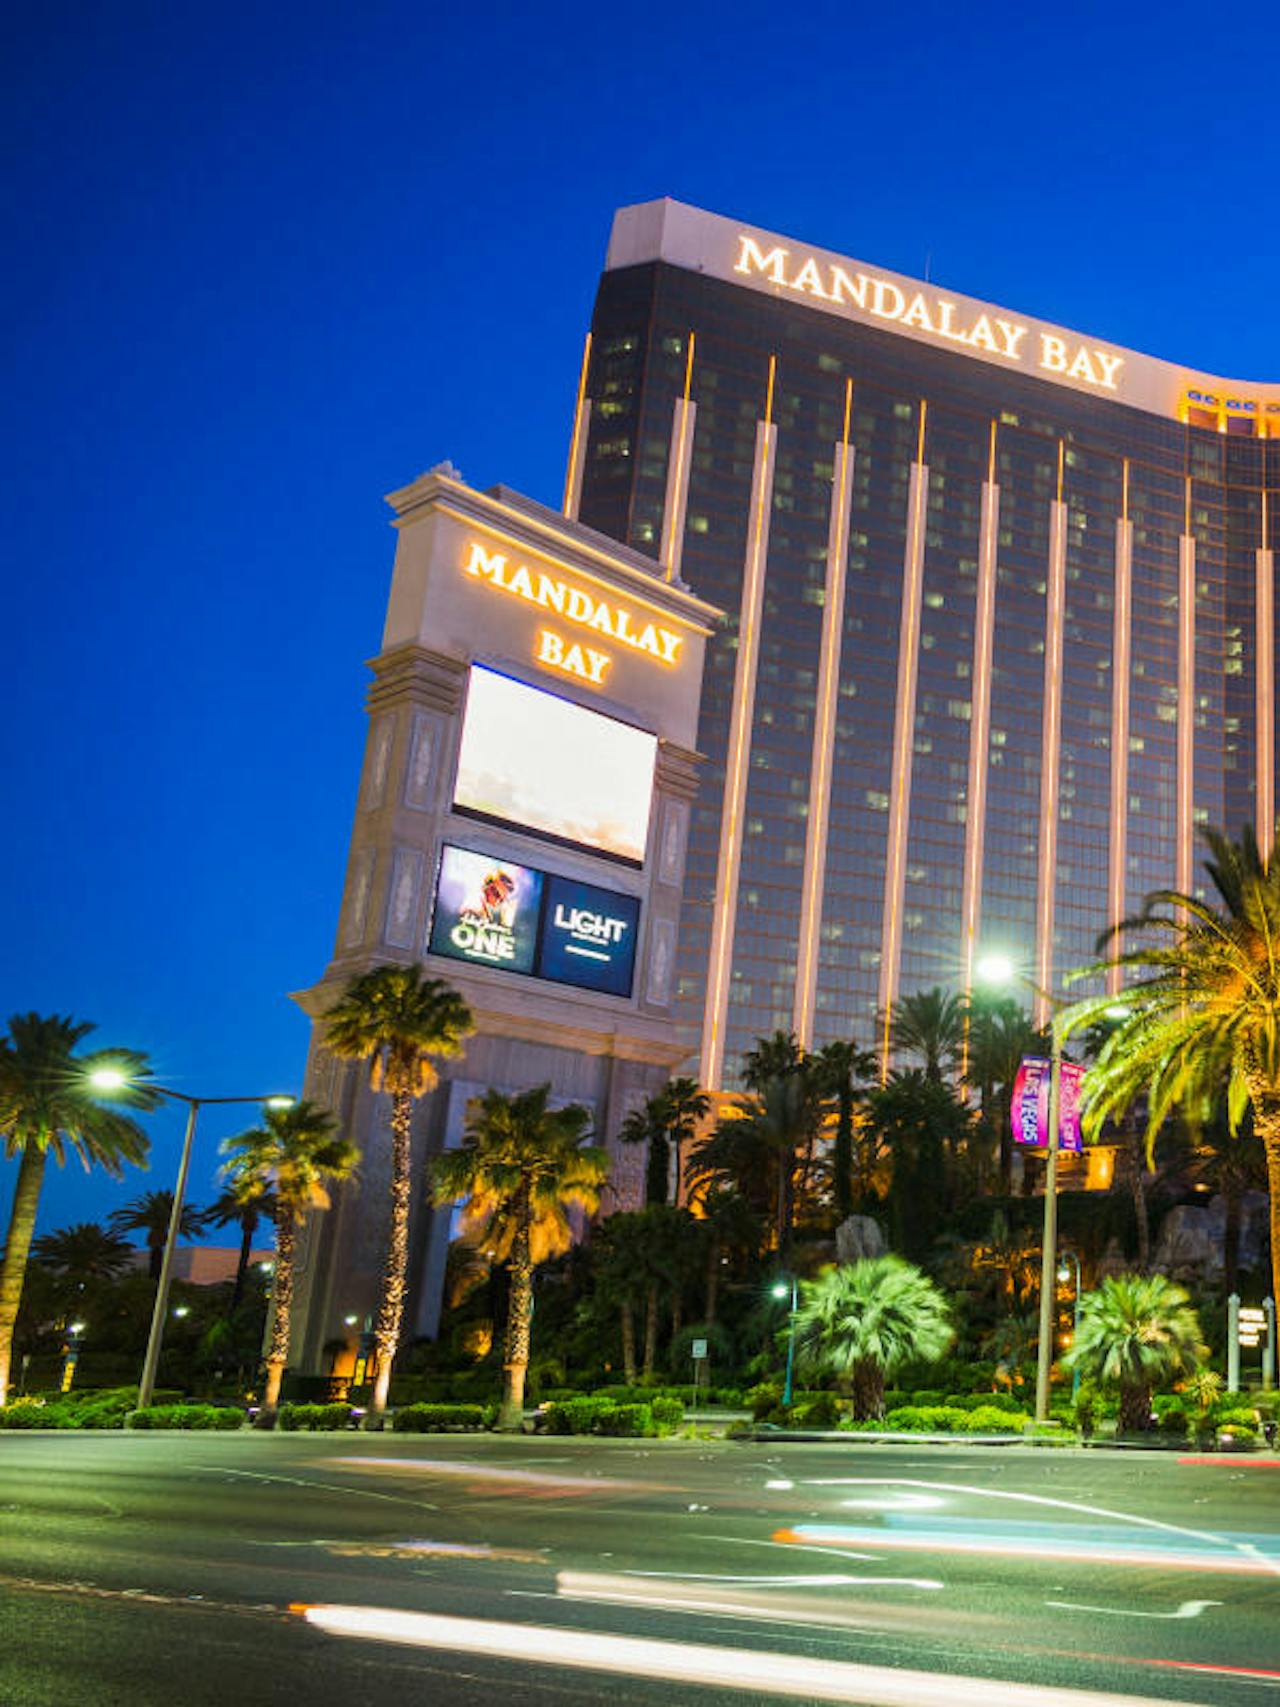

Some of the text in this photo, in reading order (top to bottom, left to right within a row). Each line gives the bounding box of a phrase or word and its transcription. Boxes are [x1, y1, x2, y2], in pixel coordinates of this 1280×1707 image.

[733, 236, 1125, 389] MANDALAY BAY
[466, 543, 683, 664] MANDALAY
[537, 630, 611, 685] BAY
[451, 924, 516, 960] ONE
[554, 904, 626, 942] LIGHT
